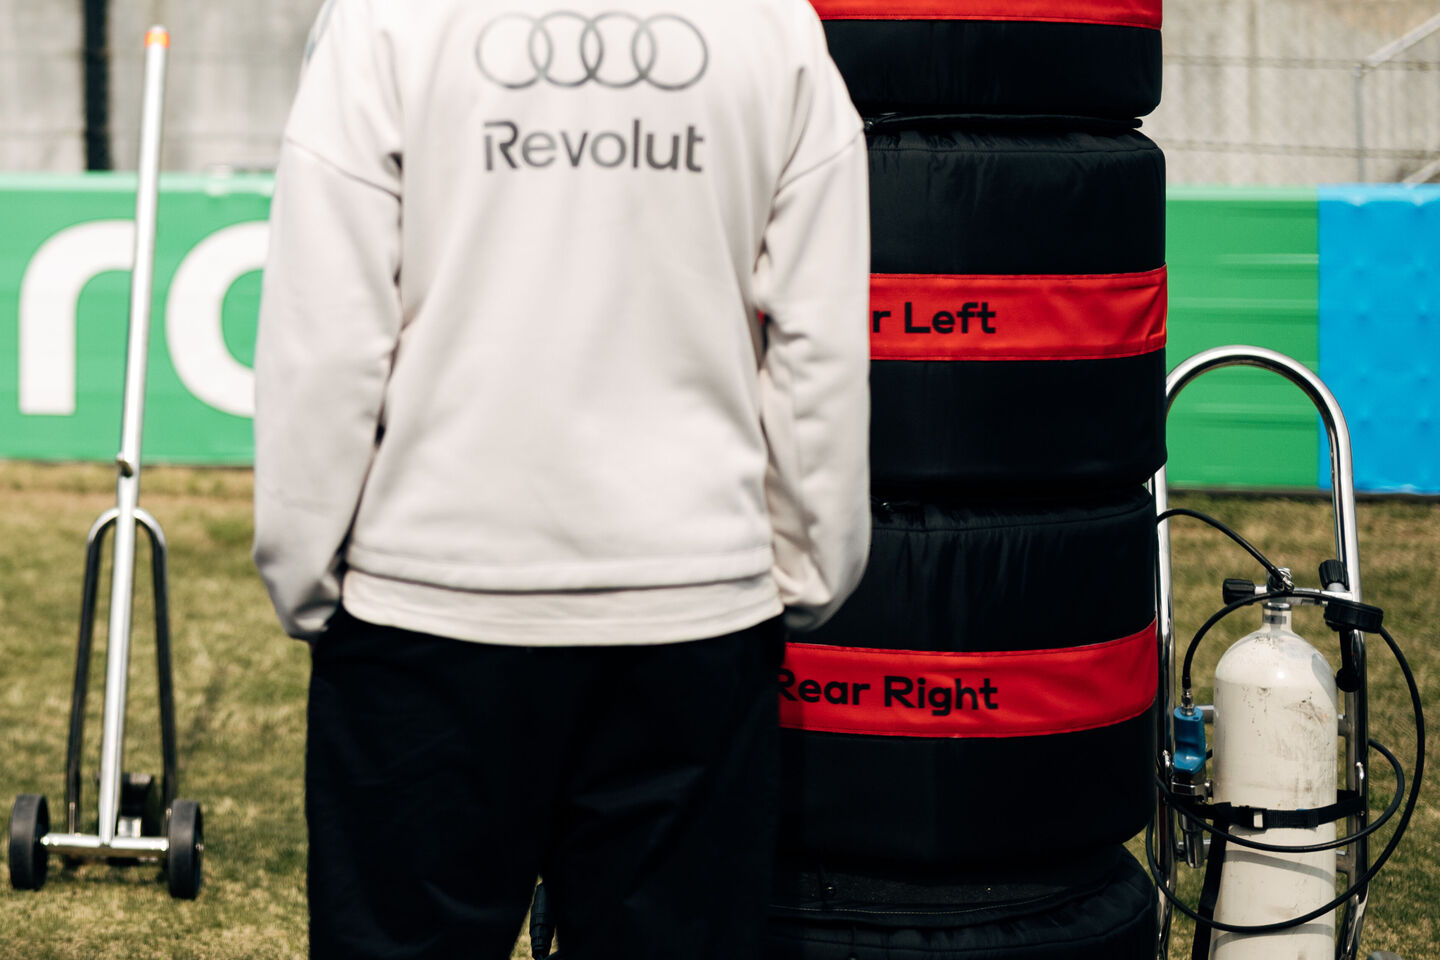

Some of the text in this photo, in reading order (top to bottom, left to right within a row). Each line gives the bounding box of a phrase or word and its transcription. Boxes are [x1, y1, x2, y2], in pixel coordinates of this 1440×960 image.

[483, 118, 705, 173] Revolut
[904, 301, 997, 334] Left
[776, 668, 999, 717] Rear Right
